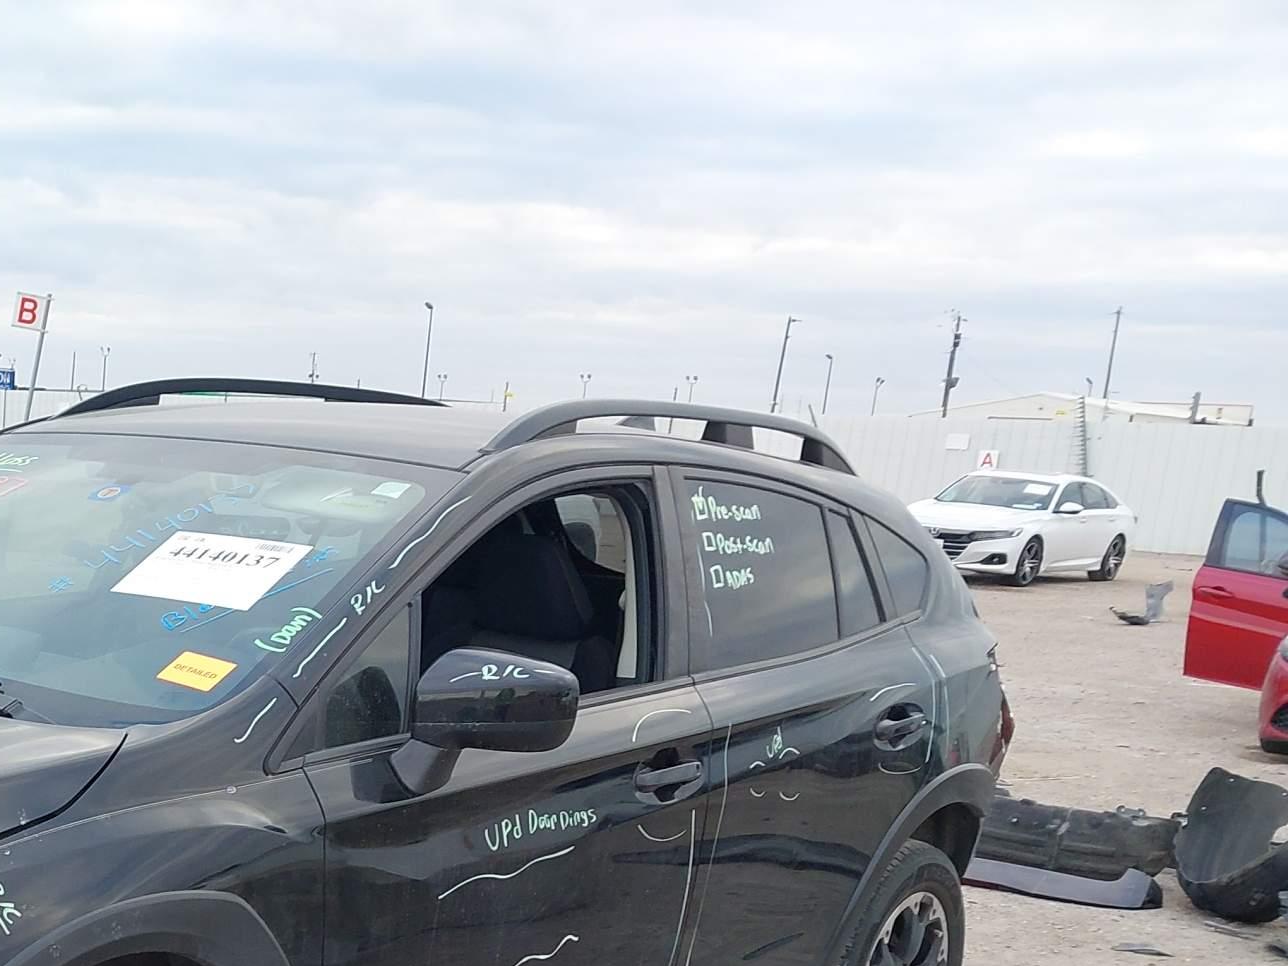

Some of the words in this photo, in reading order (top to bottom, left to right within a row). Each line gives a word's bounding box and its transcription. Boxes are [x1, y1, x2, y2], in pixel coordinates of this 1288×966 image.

[17, 297, 38, 325] B
[980, 452, 994, 468] A
[167, 546, 281, 569] 44140137
[173, 663, 218, 679] DETAILED
